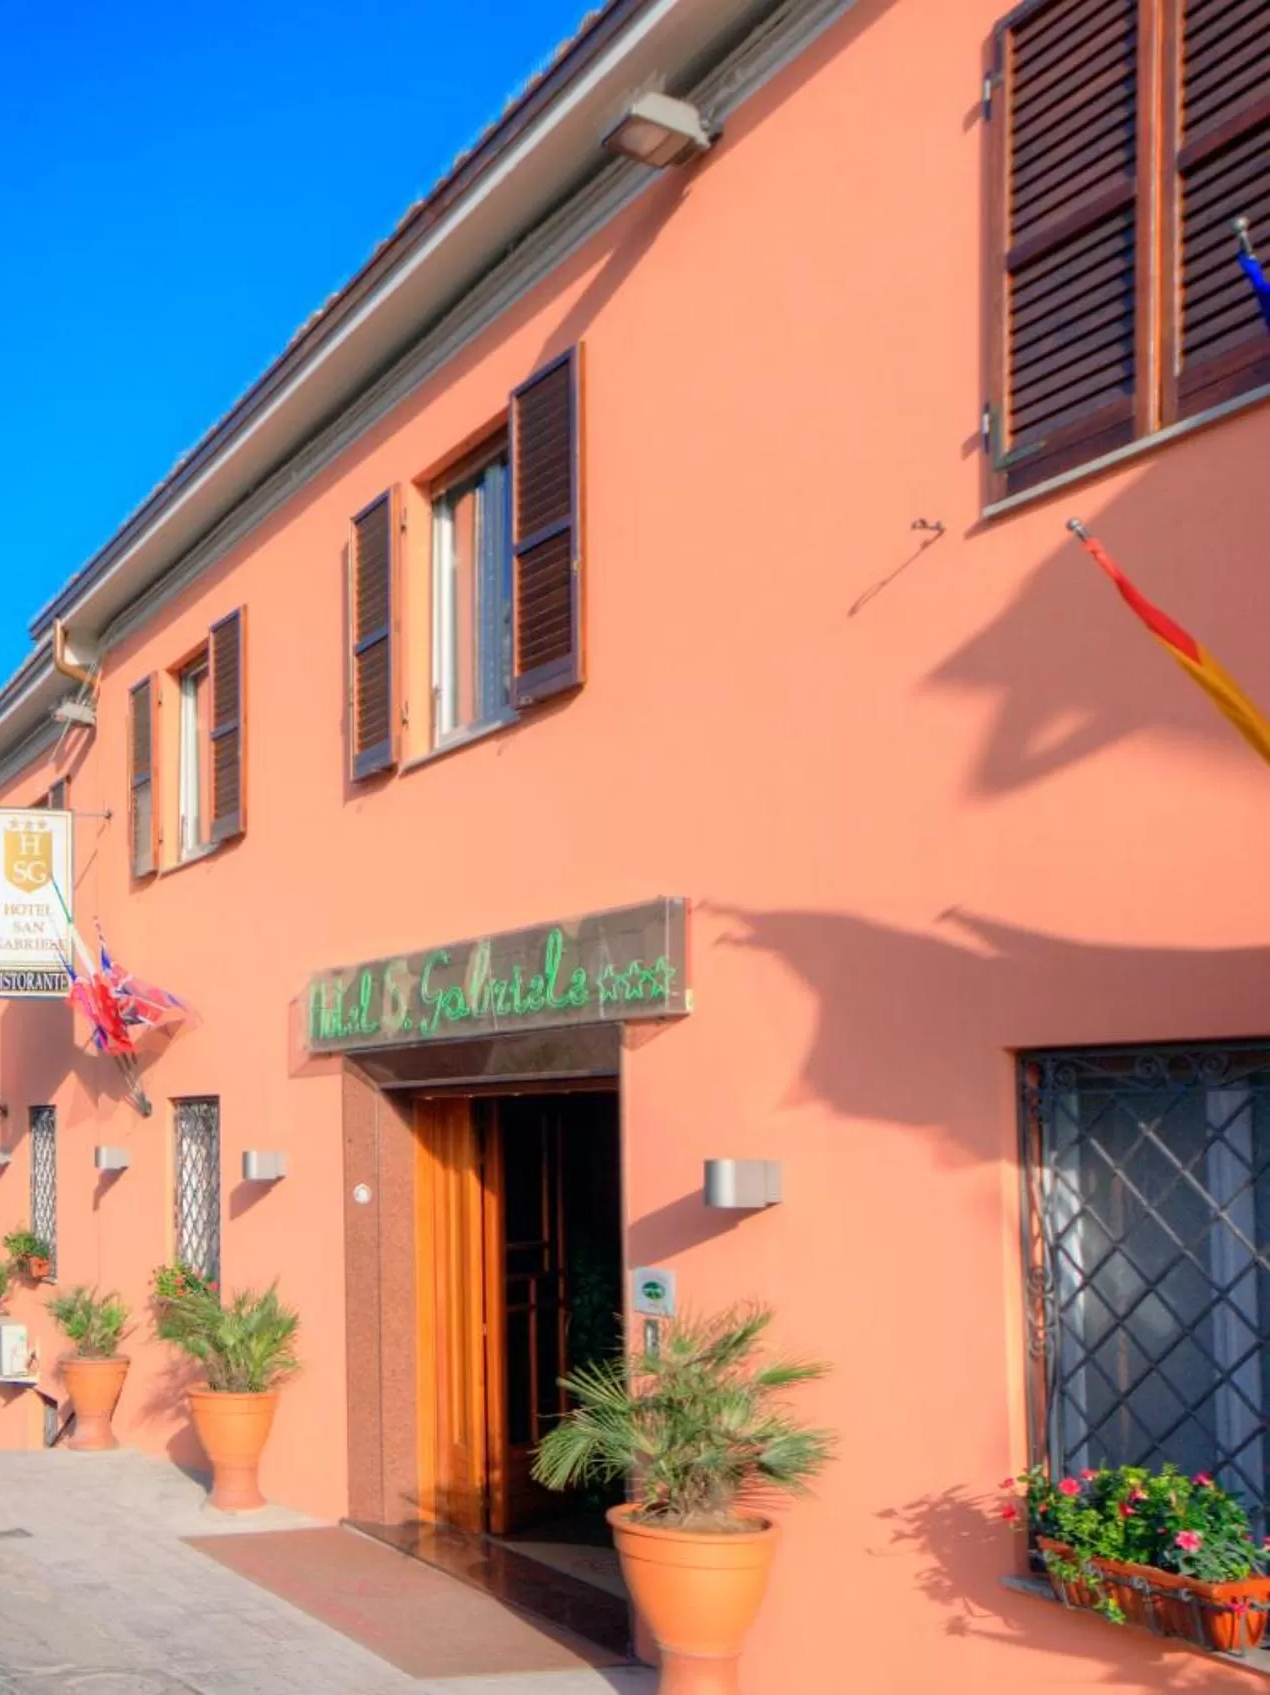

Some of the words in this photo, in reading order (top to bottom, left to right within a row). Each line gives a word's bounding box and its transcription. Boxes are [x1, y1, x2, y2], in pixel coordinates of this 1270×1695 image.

[19, 832, 42, 856] H
[13, 860, 48, 884] SG
[4, 903, 54, 917] HOTEL
[13, 920, 45, 933] SAN
